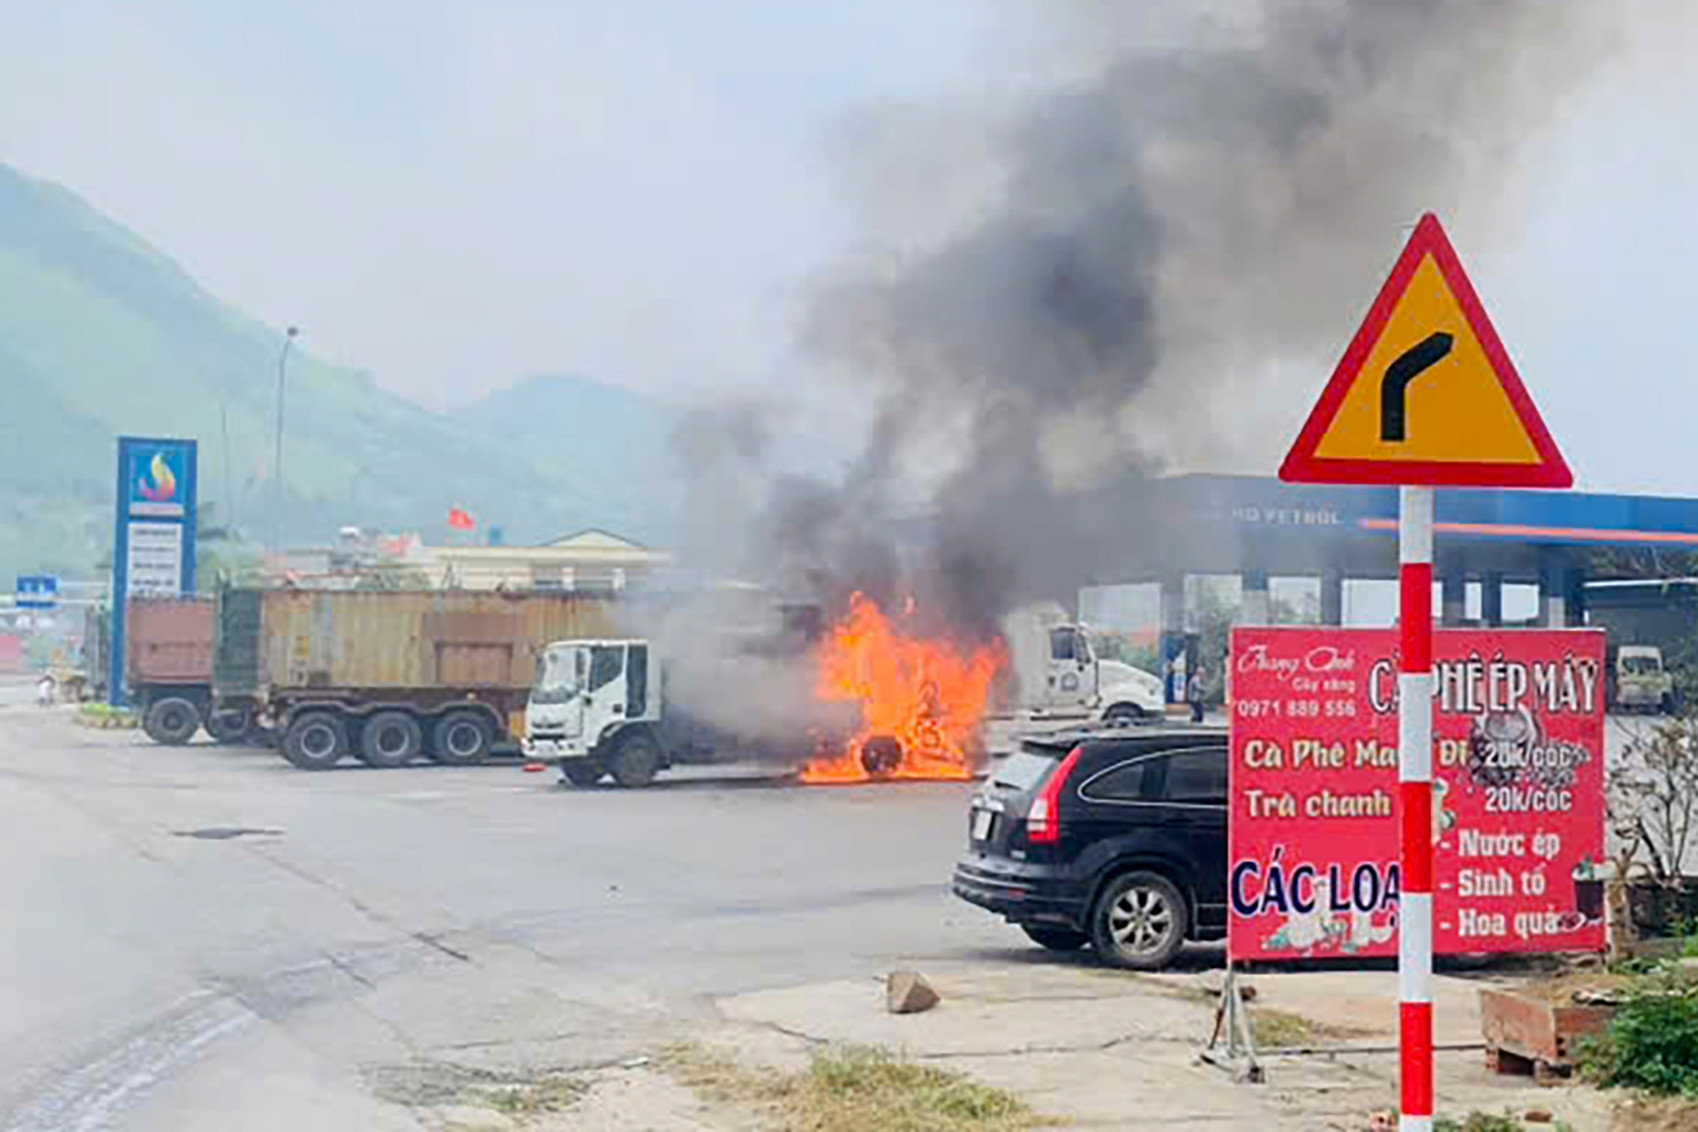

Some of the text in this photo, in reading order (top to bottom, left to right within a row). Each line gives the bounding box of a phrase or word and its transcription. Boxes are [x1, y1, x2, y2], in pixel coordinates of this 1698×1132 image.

[1488, 652, 1528, 712] ÉP
[1533, 653, 1598, 713] MÁY
[1237, 699, 1281, 718] 0971
[1324, 698, 1357, 718] 556
[1244, 738, 1284, 768] Cà
[1292, 738, 1346, 768] Phê
[1354, 739, 1400, 768] Ma
[1243, 789, 1296, 817] Trà
[1305, 789, 1392, 817] chanh
[1458, 828, 1526, 857] Nước
[1531, 829, 1561, 860] ép
[1231, 846, 1401, 929] CÁC LOẠ
[1458, 867, 1513, 896] Sinh
[1521, 862, 1548, 896] tố
[1458, 909, 1507, 937] Hoa
[1514, 904, 1560, 941] quả
